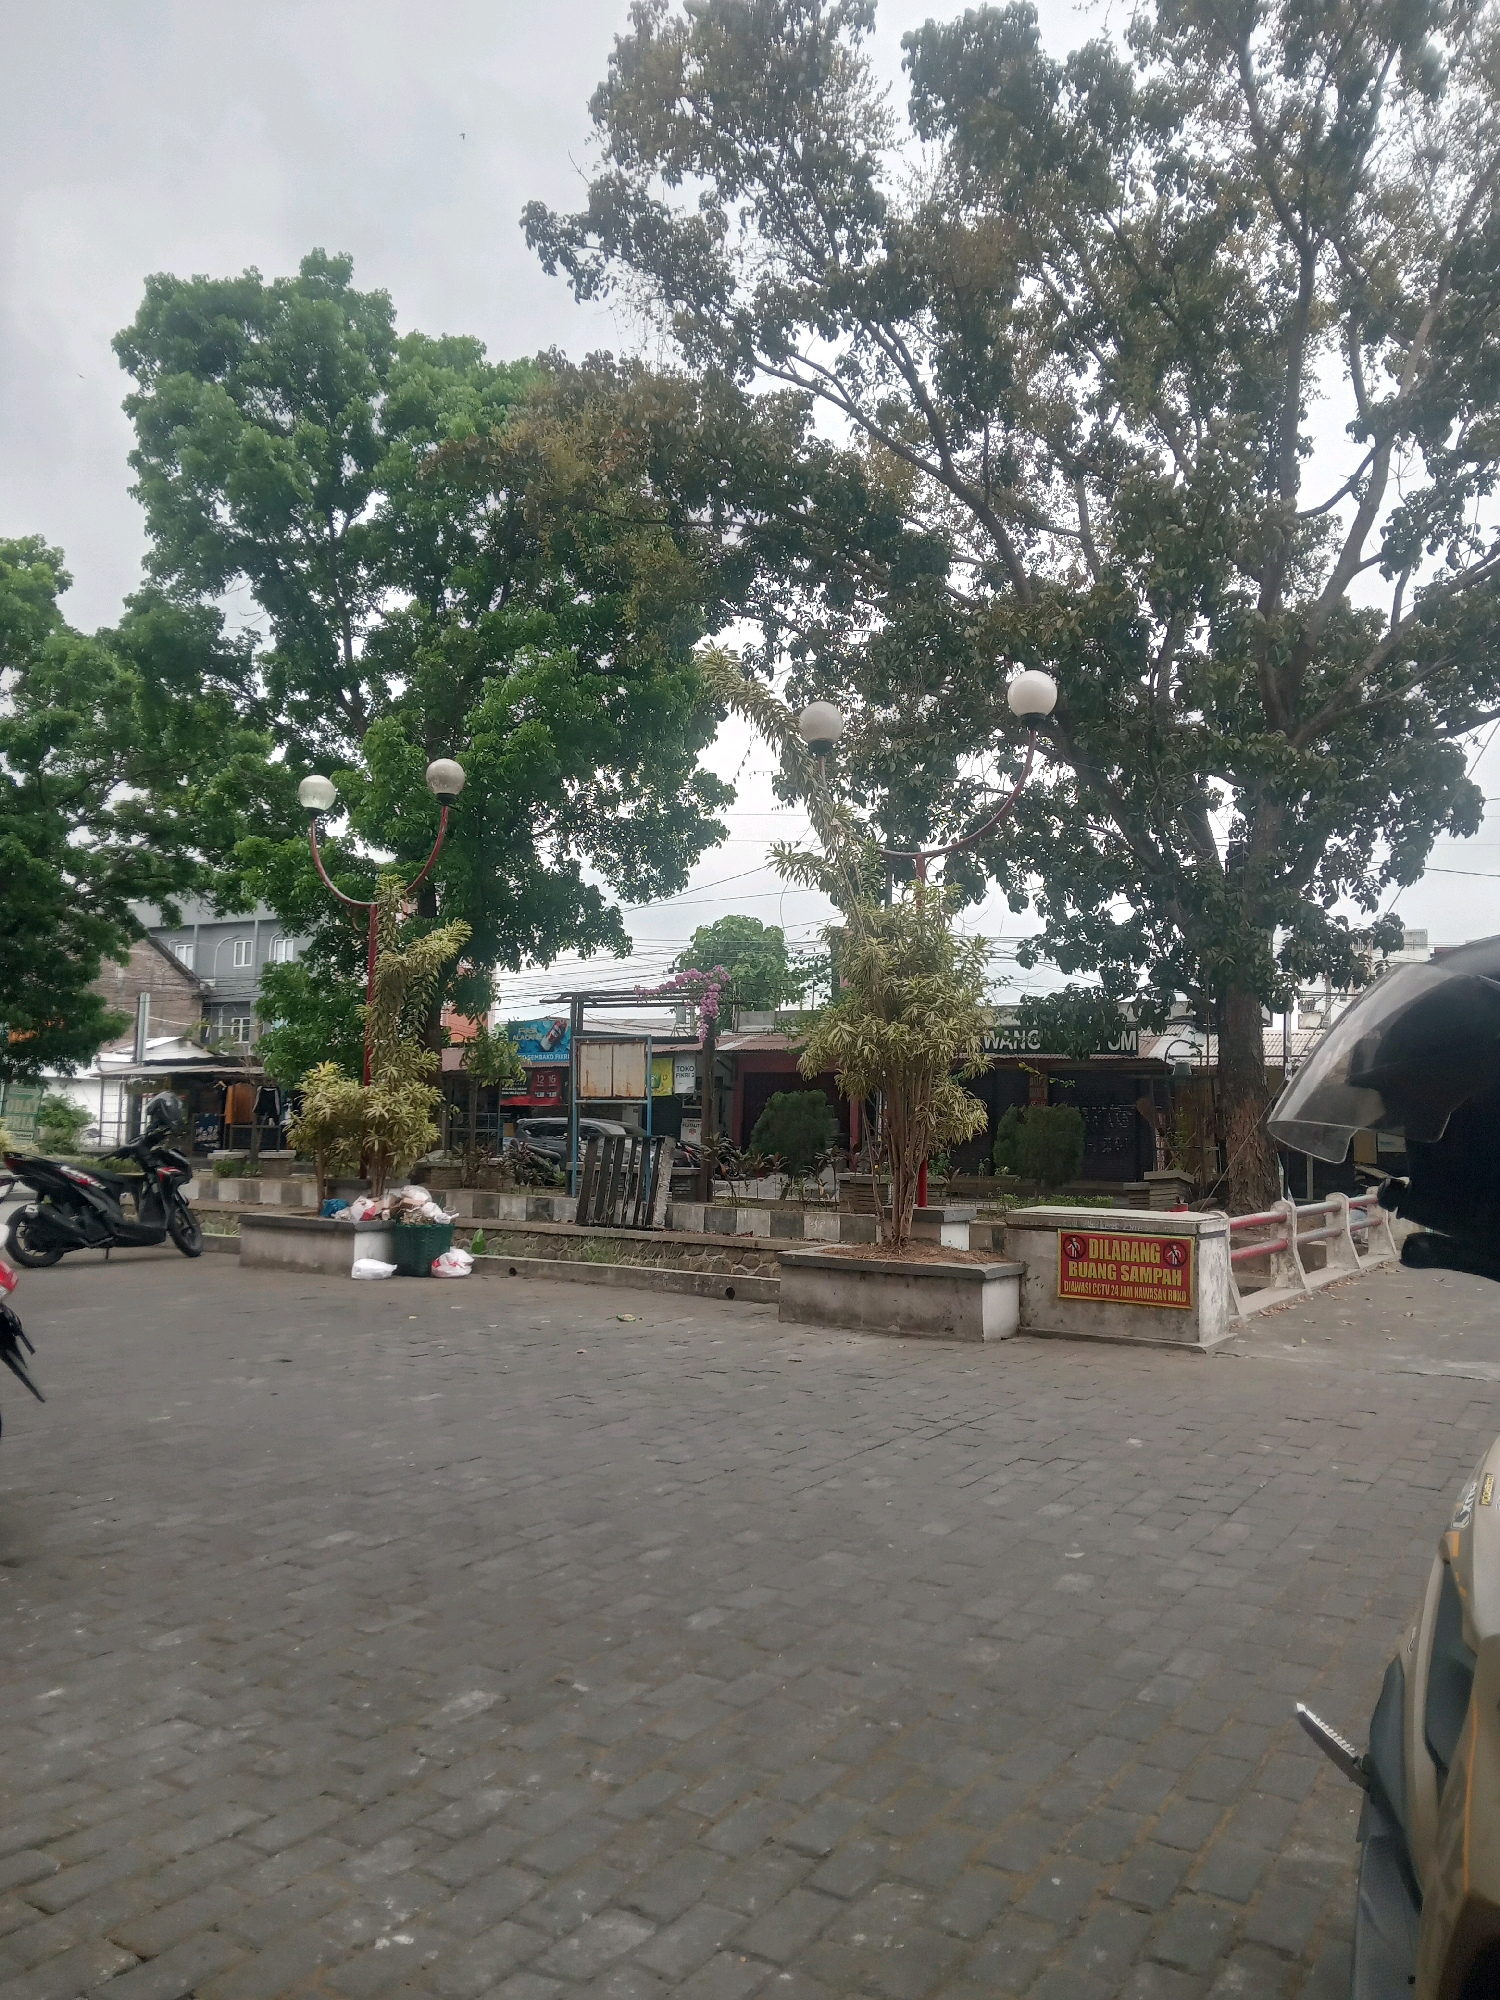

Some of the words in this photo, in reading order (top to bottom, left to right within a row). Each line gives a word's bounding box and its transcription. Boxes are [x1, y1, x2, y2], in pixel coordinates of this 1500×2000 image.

[1088, 1238, 1161, 1264] DILARANG
[1068, 1261, 1117, 1281] BUANG
[1120, 1264, 1182, 1287] SAMPAH
[1064, 1280, 1092, 1294] DIAWASI
[1092, 1282, 1111, 1296] CCTV
[1111, 1284, 1119, 1297] 24
[1120, 1285, 1133, 1298] JAM
[1134, 1286, 1167, 1301] KAWASAN
[1167, 1289, 1187, 1303] RUKO
